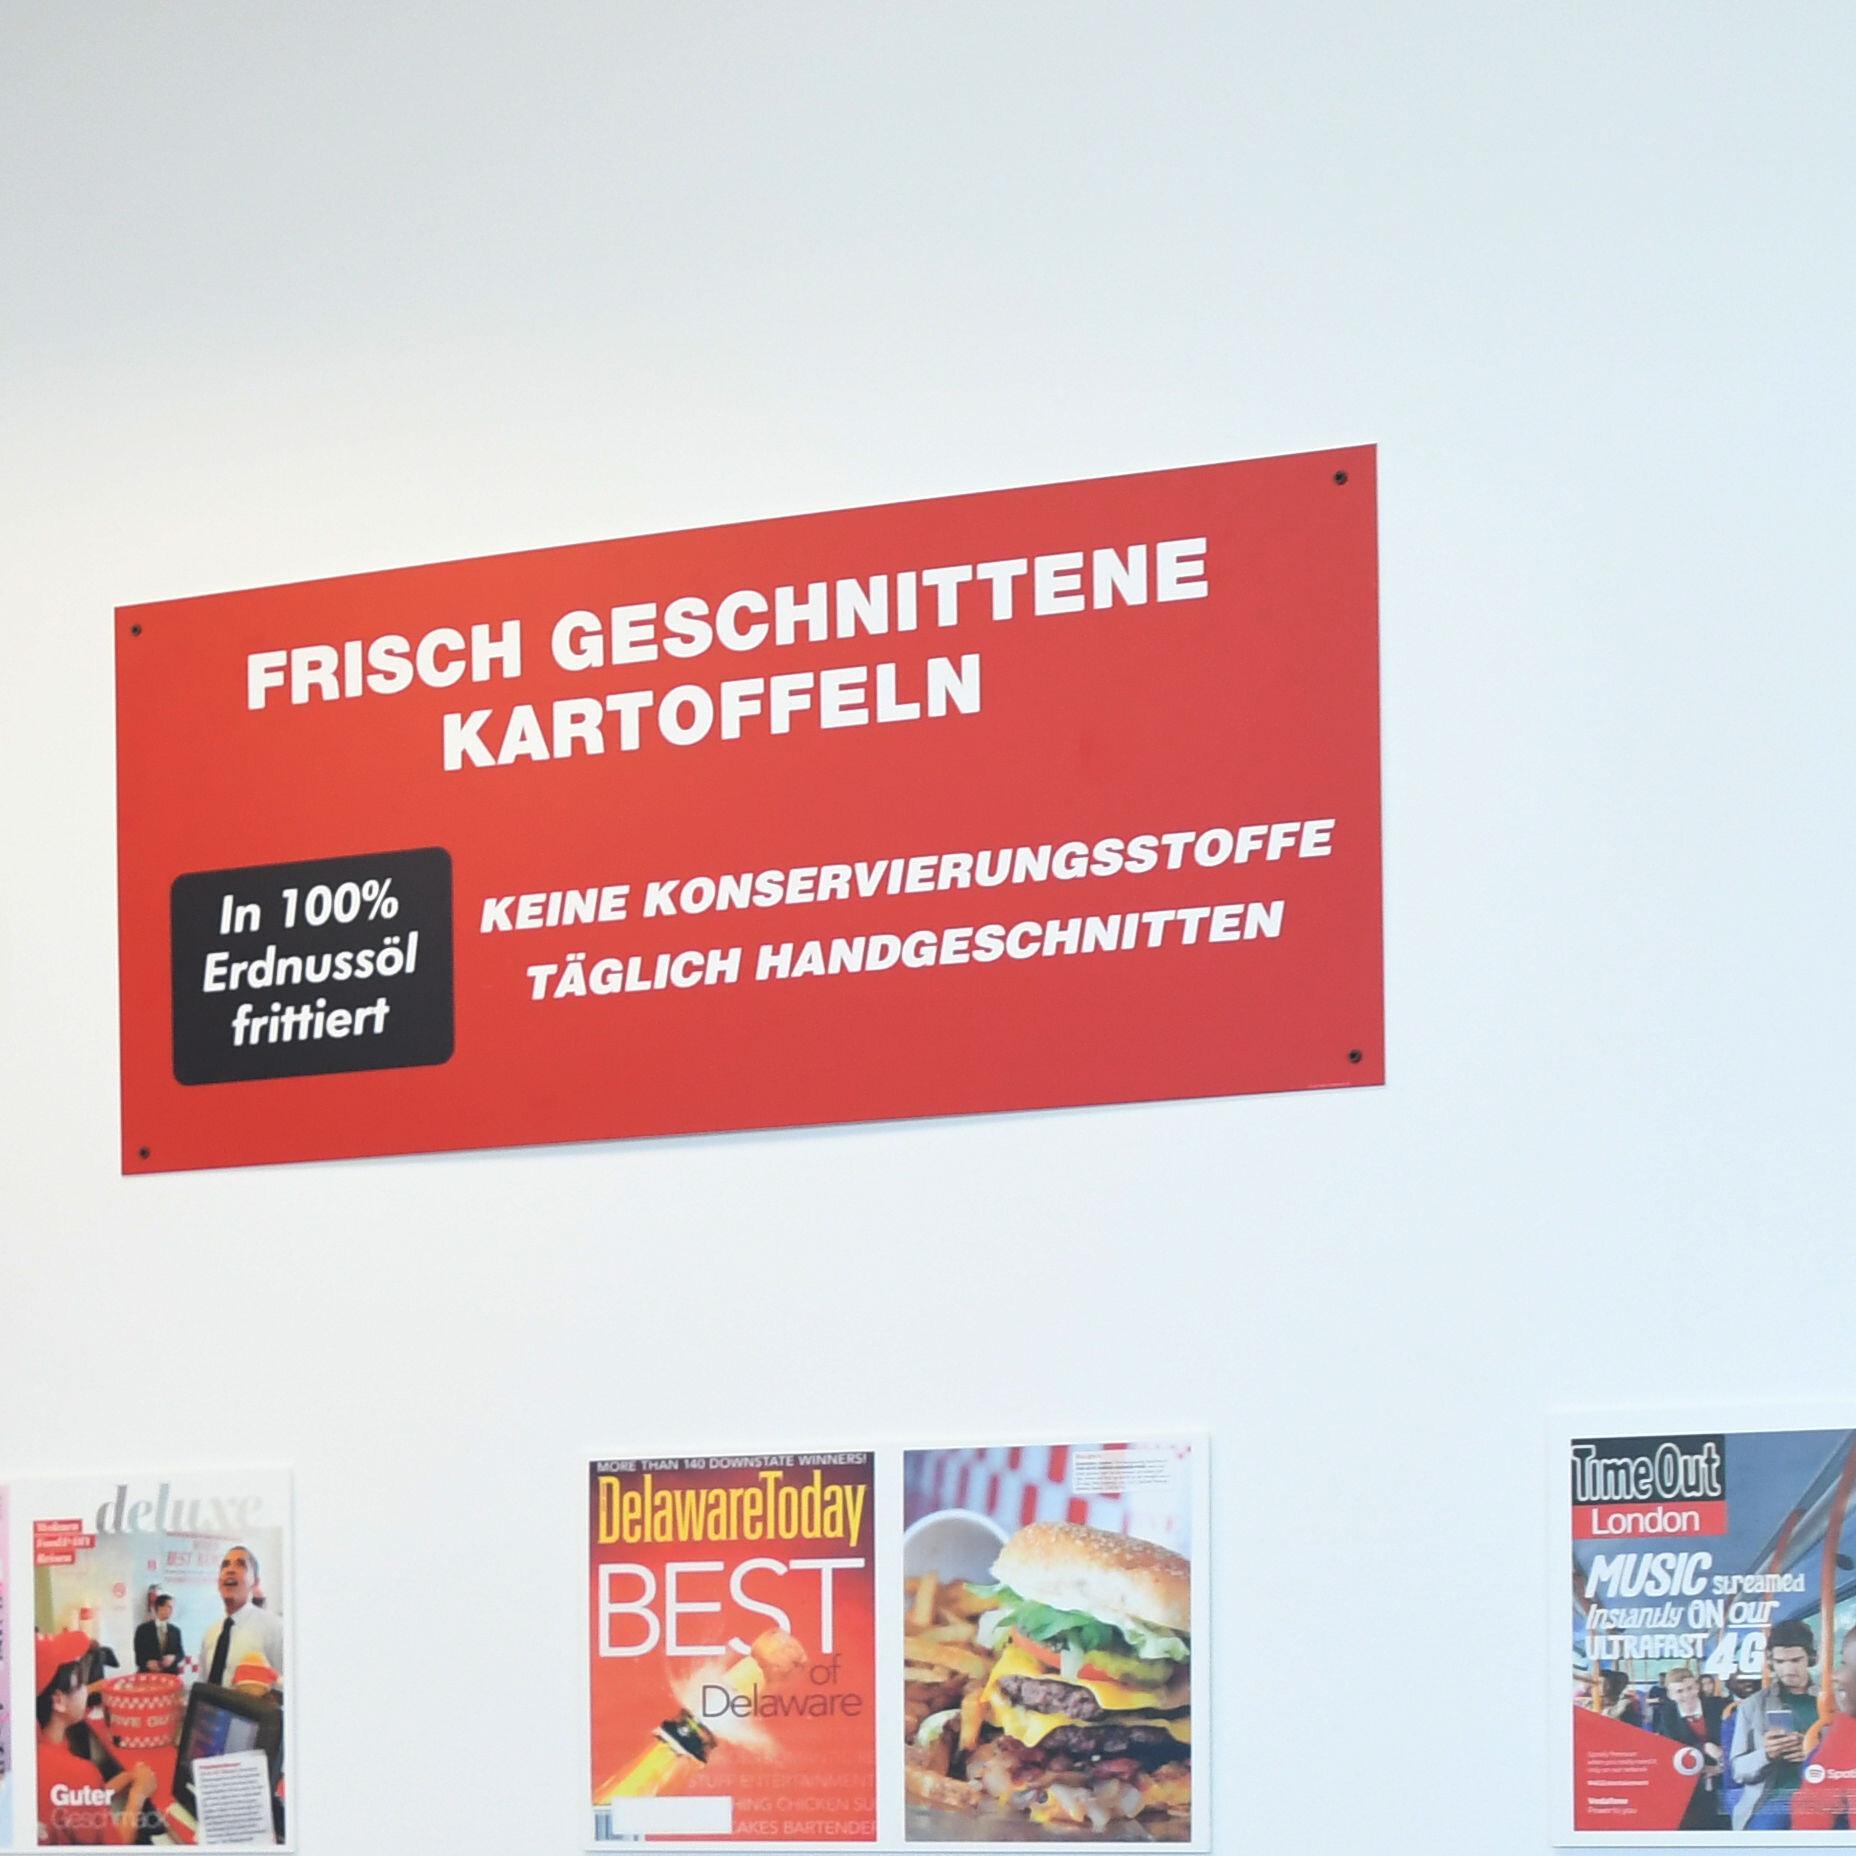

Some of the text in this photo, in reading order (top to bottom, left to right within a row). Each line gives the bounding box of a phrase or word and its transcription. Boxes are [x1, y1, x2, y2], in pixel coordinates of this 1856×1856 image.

[246, 536, 1210, 711] FRISCH GESCHNITTENE
[442, 652, 982, 773] KARTOFFELN
[479, 817, 1337, 935] KEINE KONSERVIERUNGSSTOFFE
[219, 876, 400, 936] In 100%
[202, 929, 420, 994] Erdnussöl
[525, 899, 1286, 1002] TÄGLICH HANDGESCHNITTEN
[230, 995, 391, 1048] frittiert
[596, 1461, 637, 1473] MORE
[641, 1459, 679, 1471] THAN
[708, 1455, 795, 1470] DOWNSTATE
[799, 1453, 868, 1467] WINNERS!
[1572, 1442, 1722, 1501] Time Out
[95, 1483, 265, 1536] deluxe
[1591, 1506, 1700, 1536] London
[1584, 1551, 1806, 1599] MUSIC streamed
[597, 1557, 866, 1658] BEST
[1687, 1599, 1725, 1629] ON
[1727, 1600, 1780, 1625] our
[809, 1653, 843, 1686] of
[1583, 1631, 1770, 1681] ULTRAFAST 4G
[700, 1682, 863, 1719] Delaware
[50, 1783, 116, 1807] Guter
[776, 1796, 850, 1812] CHICKEN
